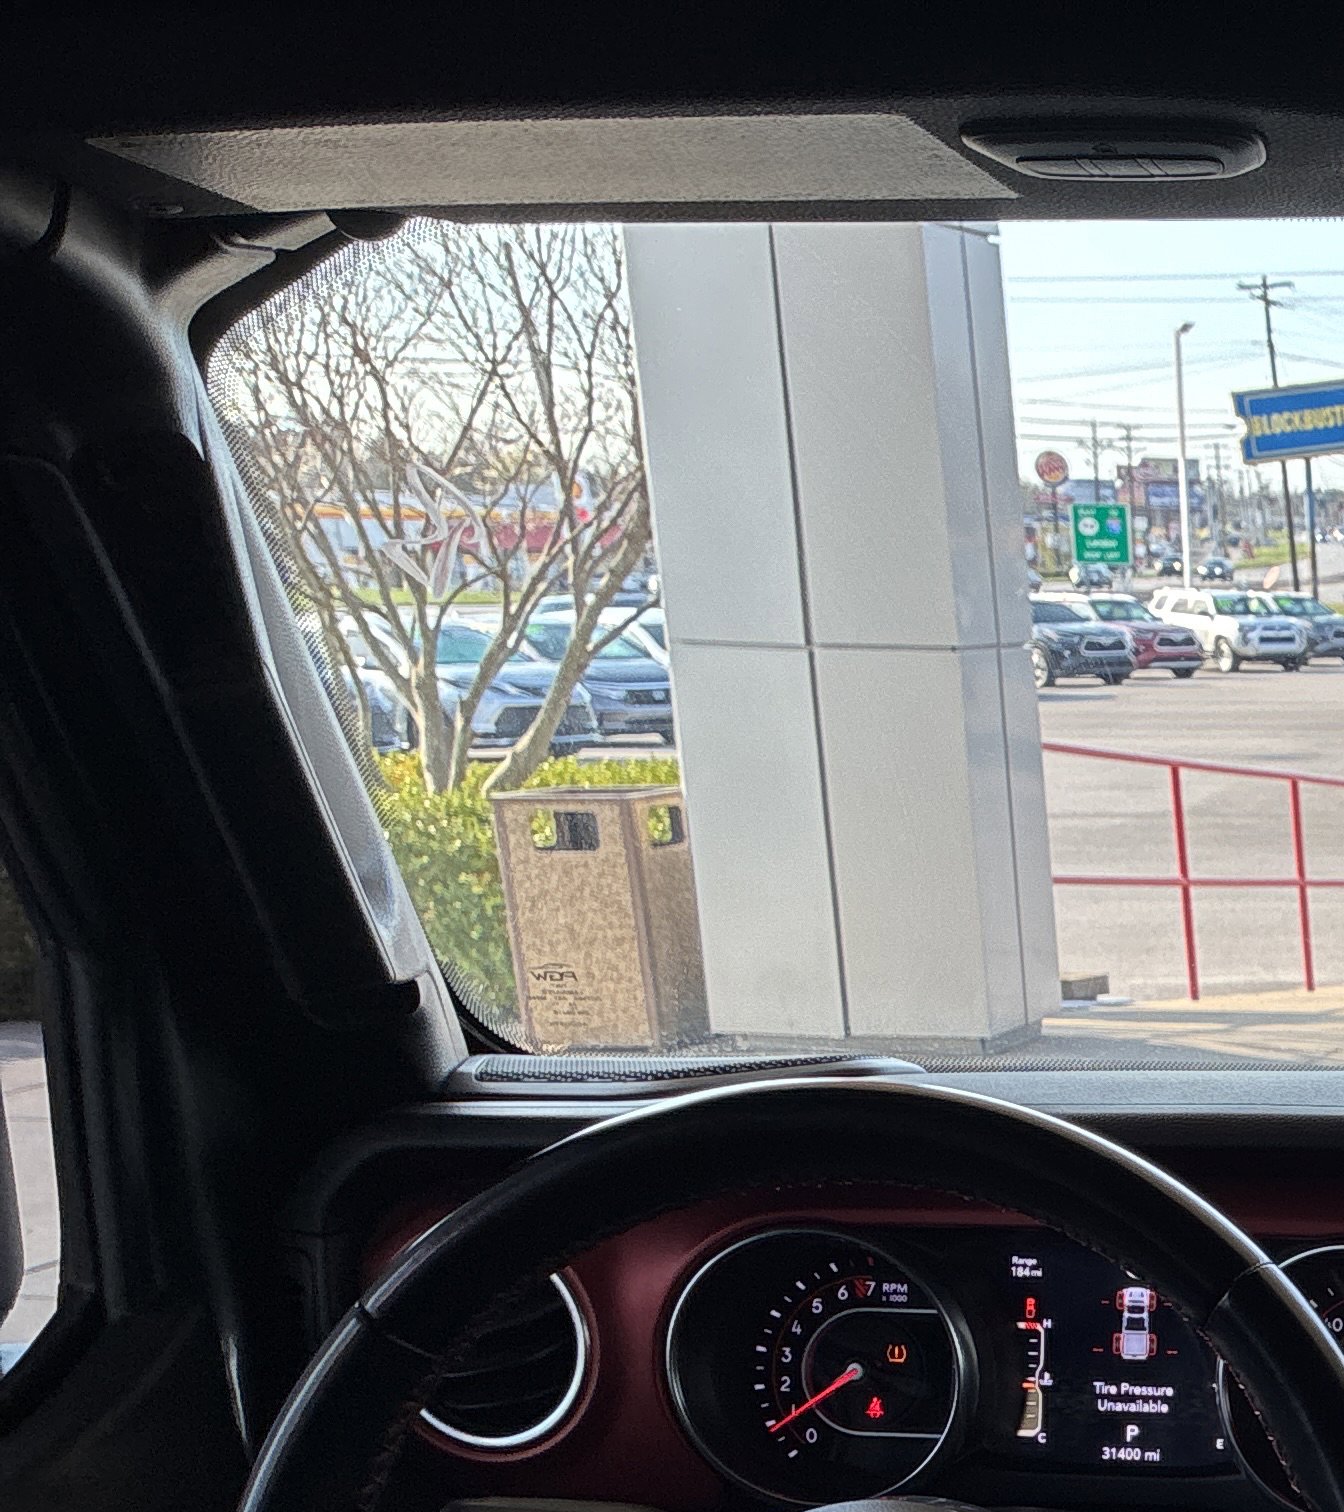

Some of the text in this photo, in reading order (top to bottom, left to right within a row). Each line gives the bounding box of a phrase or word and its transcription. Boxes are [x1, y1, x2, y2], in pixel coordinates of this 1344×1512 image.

[1011, 1255, 1037, 1266] Range
[1011, 1266, 1030, 1277] 184
[837, 1285, 849, 1300] 6
[865, 1281, 877, 1296] 7
[882, 1283, 908, 1294] RPM
[811, 1298, 823, 1314] 5
[791, 1320, 802, 1335] 4
[1043, 1318, 1052, 1329] H
[781, 1347, 792, 1363] 3
[780, 1377, 791, 1393] 2
[1093, 1382, 1174, 1397] Tire Pressure
[1097, 1400, 1169, 1414] Unavailable
[806, 1427, 817, 1443] 0
[1037, 1433, 1047, 1443] C
[1126, 1425, 1139, 1442] P
[1216, 1438, 1224, 1449] E
[1101, 1447, 1161, 1462] 31400 mi
